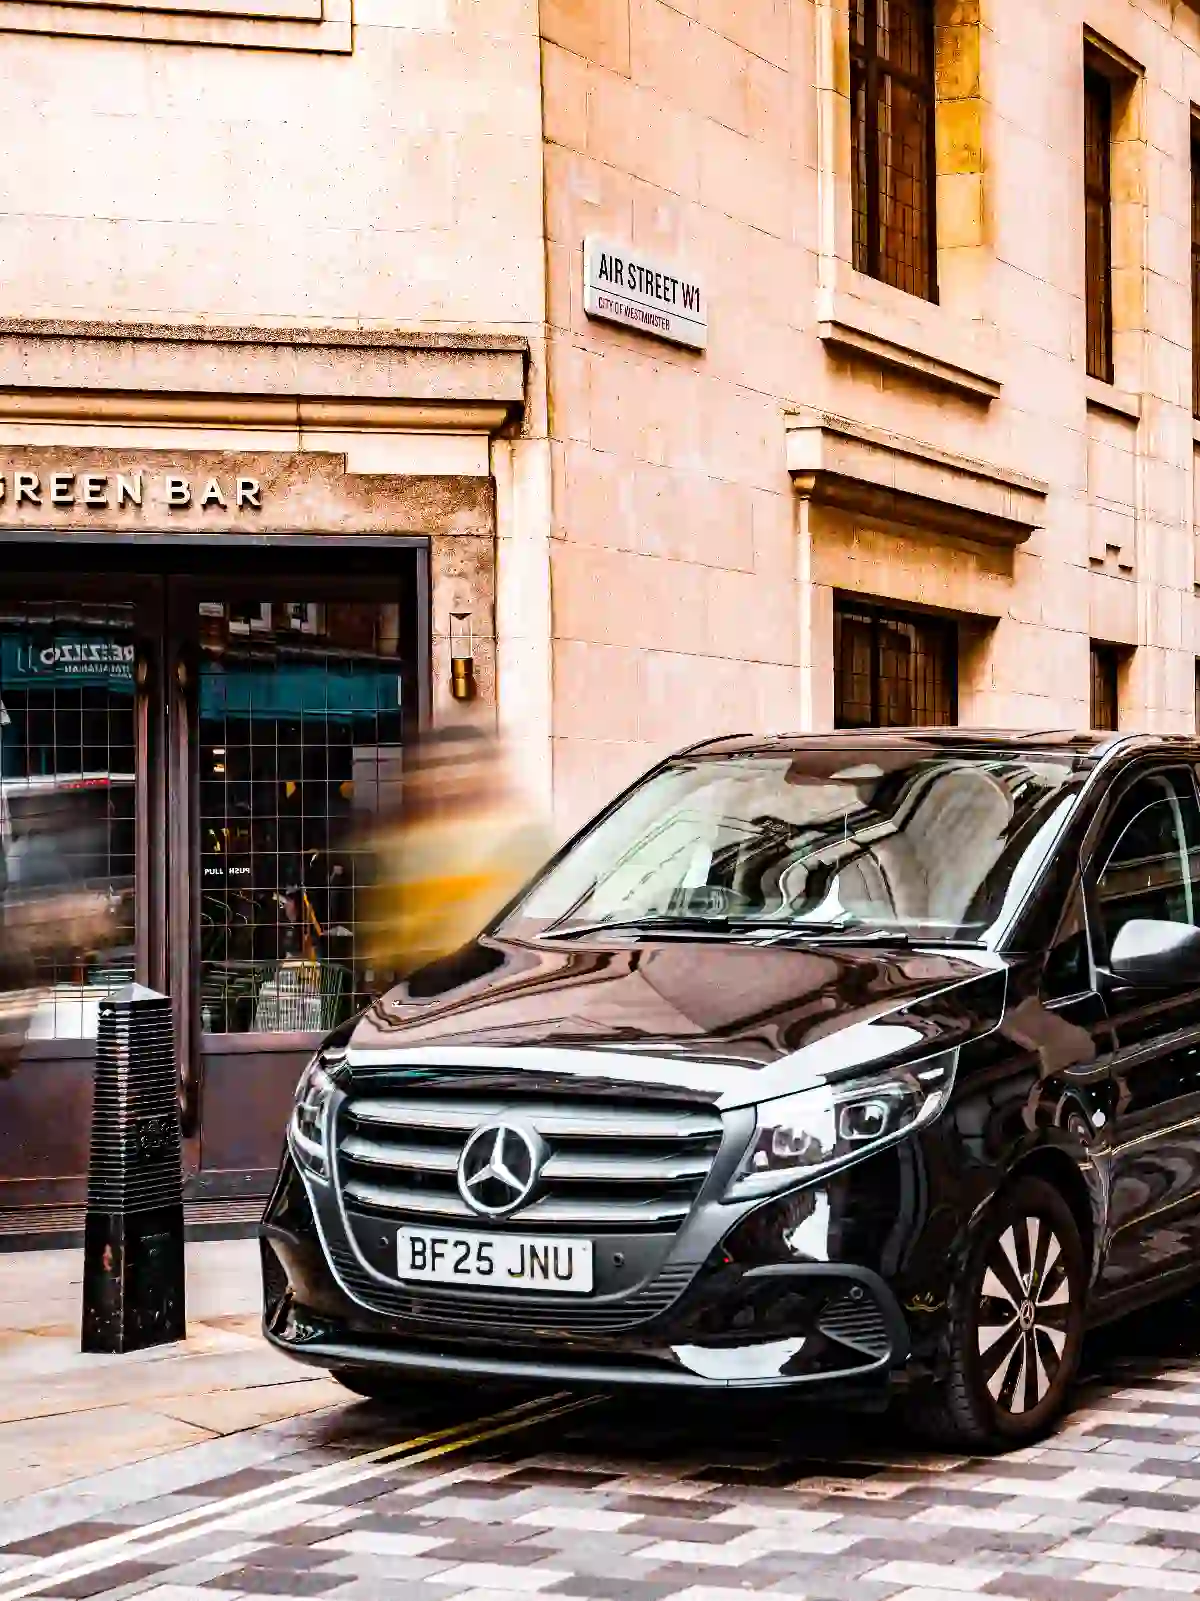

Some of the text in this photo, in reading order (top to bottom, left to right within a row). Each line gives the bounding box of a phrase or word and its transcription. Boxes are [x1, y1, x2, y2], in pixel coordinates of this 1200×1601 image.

[599, 253, 700, 313] AIR STREET W1
[598, 296, 614, 313] CITY
[624, 305, 670, 331] WESTMINSTER
[165, 475, 262, 510] BAR
[204, 868, 224, 876] PULL
[410, 1236, 573, 1281] BF25 JNU
